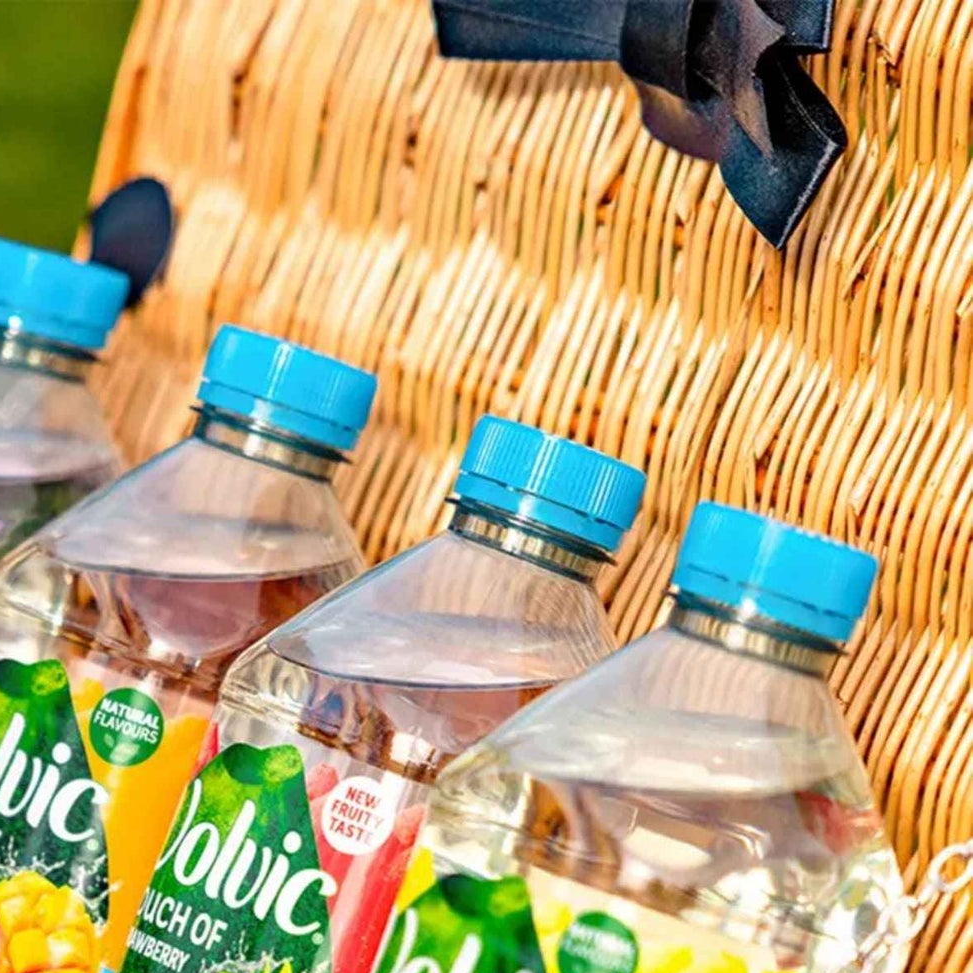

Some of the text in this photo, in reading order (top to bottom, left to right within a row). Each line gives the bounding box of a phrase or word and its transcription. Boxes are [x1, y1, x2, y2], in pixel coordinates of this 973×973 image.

[93, 709, 158, 745] FLAVOURS
[100, 697, 159, 730] NATURAL
[345, 786, 381, 809] NEW
[331, 799, 385, 830] FRUITY
[329, 816, 374, 847] TASTE
[189, 912, 229, 951] OF
